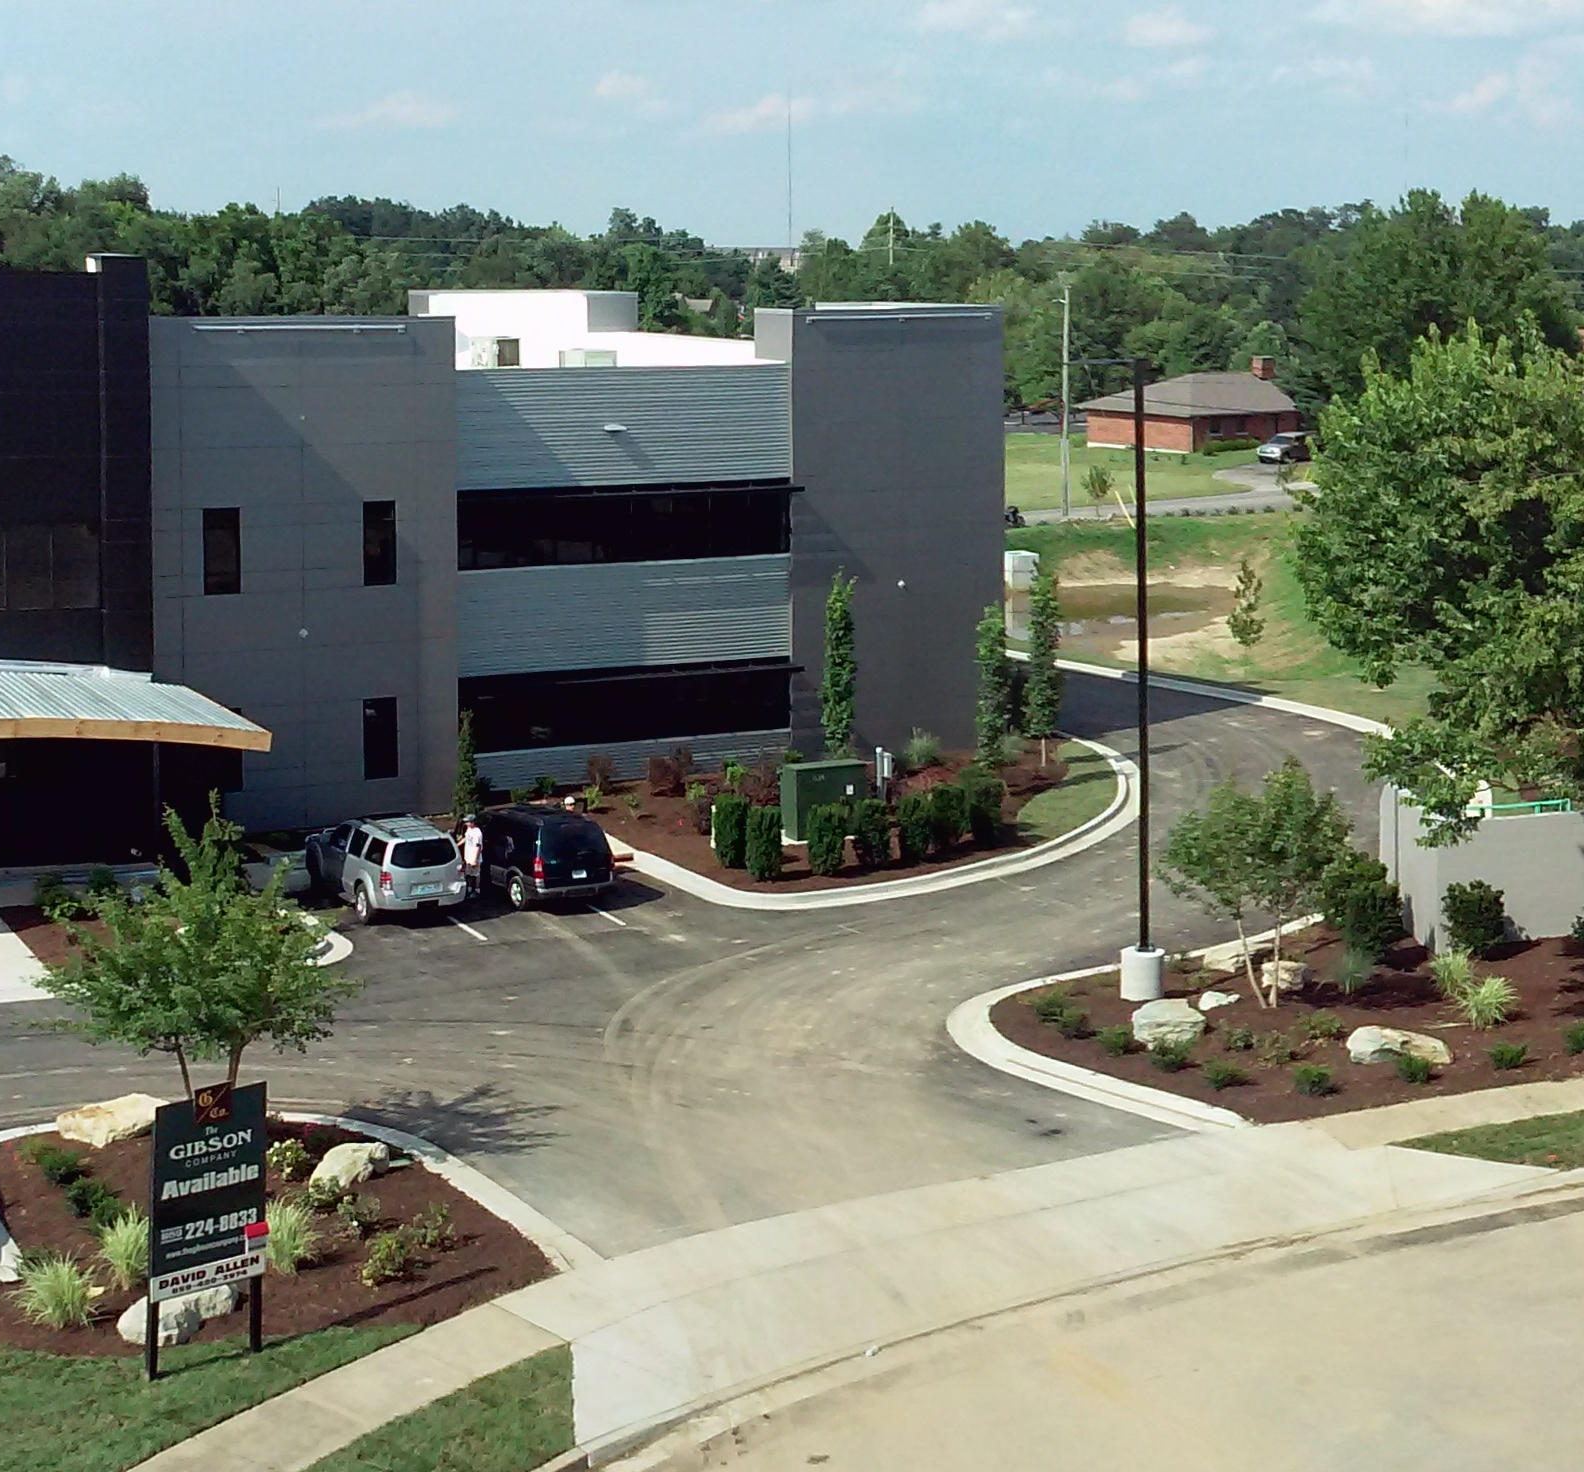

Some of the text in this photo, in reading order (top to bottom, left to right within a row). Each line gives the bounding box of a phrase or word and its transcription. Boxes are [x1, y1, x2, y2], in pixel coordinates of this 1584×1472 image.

[169, 1129, 252, 1160] GIBSON
[205, 1126, 219, 1136] The
[185, 1150, 238, 1168] COMPANY
[161, 1164, 259, 1200] Available
[185, 1207, 257, 1240] 224-8833
[159, 1255, 260, 1290] DAVID ALLEN
